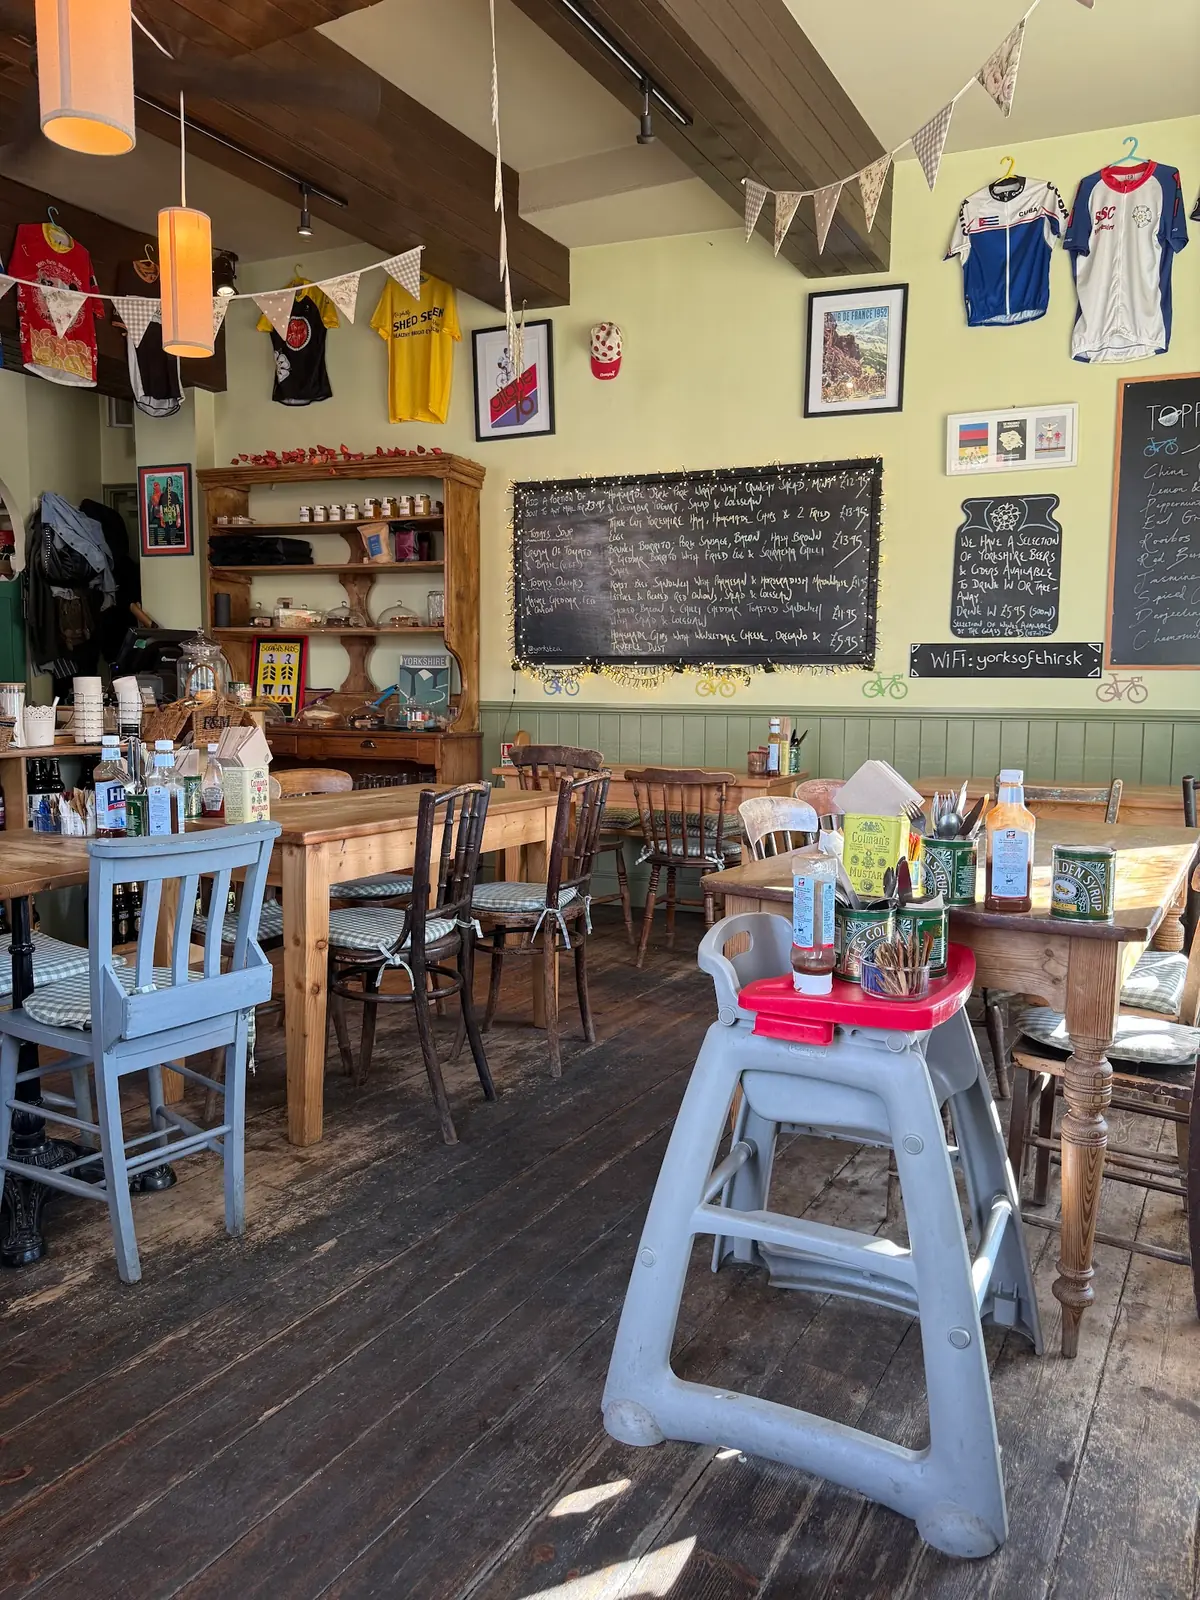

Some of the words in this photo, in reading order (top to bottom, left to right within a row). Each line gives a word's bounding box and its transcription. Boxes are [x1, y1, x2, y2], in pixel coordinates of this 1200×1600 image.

[1018, 206, 1038, 217] CUBA
[1095, 206, 1116, 225] SSC
[393, 315, 418, 332] SHED
[420, 306, 445, 323] SEEN
[843, 311, 850, 321] DE
[851, 308, 873, 320] FRANCE
[874, 307, 888, 318] 1952
[1143, 463, 1189, 479] China
[673, 485, 689, 501] PORK
[1146, 482, 1188, 498] Lemon
[713, 498, 720, 510] &
[629, 515, 642, 529] CUT
[646, 514, 684, 530] YORKSHIRE
[756, 509, 777, 525] CHIPS
[782, 509, 791, 519] &
[797, 506, 805, 519] 2
[809, 507, 830, 522] FRIED
[678, 534, 696, 550] PORK
[791, 528, 822, 547] BROWN
[960, 535, 976, 548] WE
[980, 533, 1003, 553] HAVE
[1007, 534, 1015, 554] A
[1016, 532, 1059, 549] SELECTION
[1138, 528, 1191, 554] Rooibos
[705, 549, 729, 564] FRIED
[747, 549, 755, 559] &
[960, 552, 973, 562] OF
[977, 548, 1028, 567] YORKSHIRE
[1028, 548, 1057, 567] BEERS
[1136, 552, 1165, 569] Red
[751, 575, 758, 585] &
[959, 564, 967, 576] &
[970, 563, 999, 581] CIDERS
[1002, 564, 1058, 582] AVAILABLE
[957, 578, 968, 590] TO
[971, 577, 999, 593] DRINK
[1017, 579, 1034, 596] OR
[636, 591, 644, 601] &
[673, 591, 688, 604] RED
[749, 589, 758, 600] &
[1133, 585, 1187, 610] Spiced
[955, 604, 983, 619] DRINK
[1000, 603, 1027, 624] £5.95
[952, 619, 983, 629] SELECTION
[986, 620, 996, 628] OF
[967, 627, 979, 637] THE
[812, 631, 821, 643] &
[646, 641, 667, 653] DUST
[403, 656, 446, 666] YORKSHIRE
[976, 649, 1083, 670] yorksofthirsk
[851, 831, 890, 846] Colman's
[849, 866, 885, 881] MUSTAR
[930, 860, 949, 896] SYRUP
[1082, 875, 1103, 912] SYRUP
[865, 925, 887, 941] GOL
